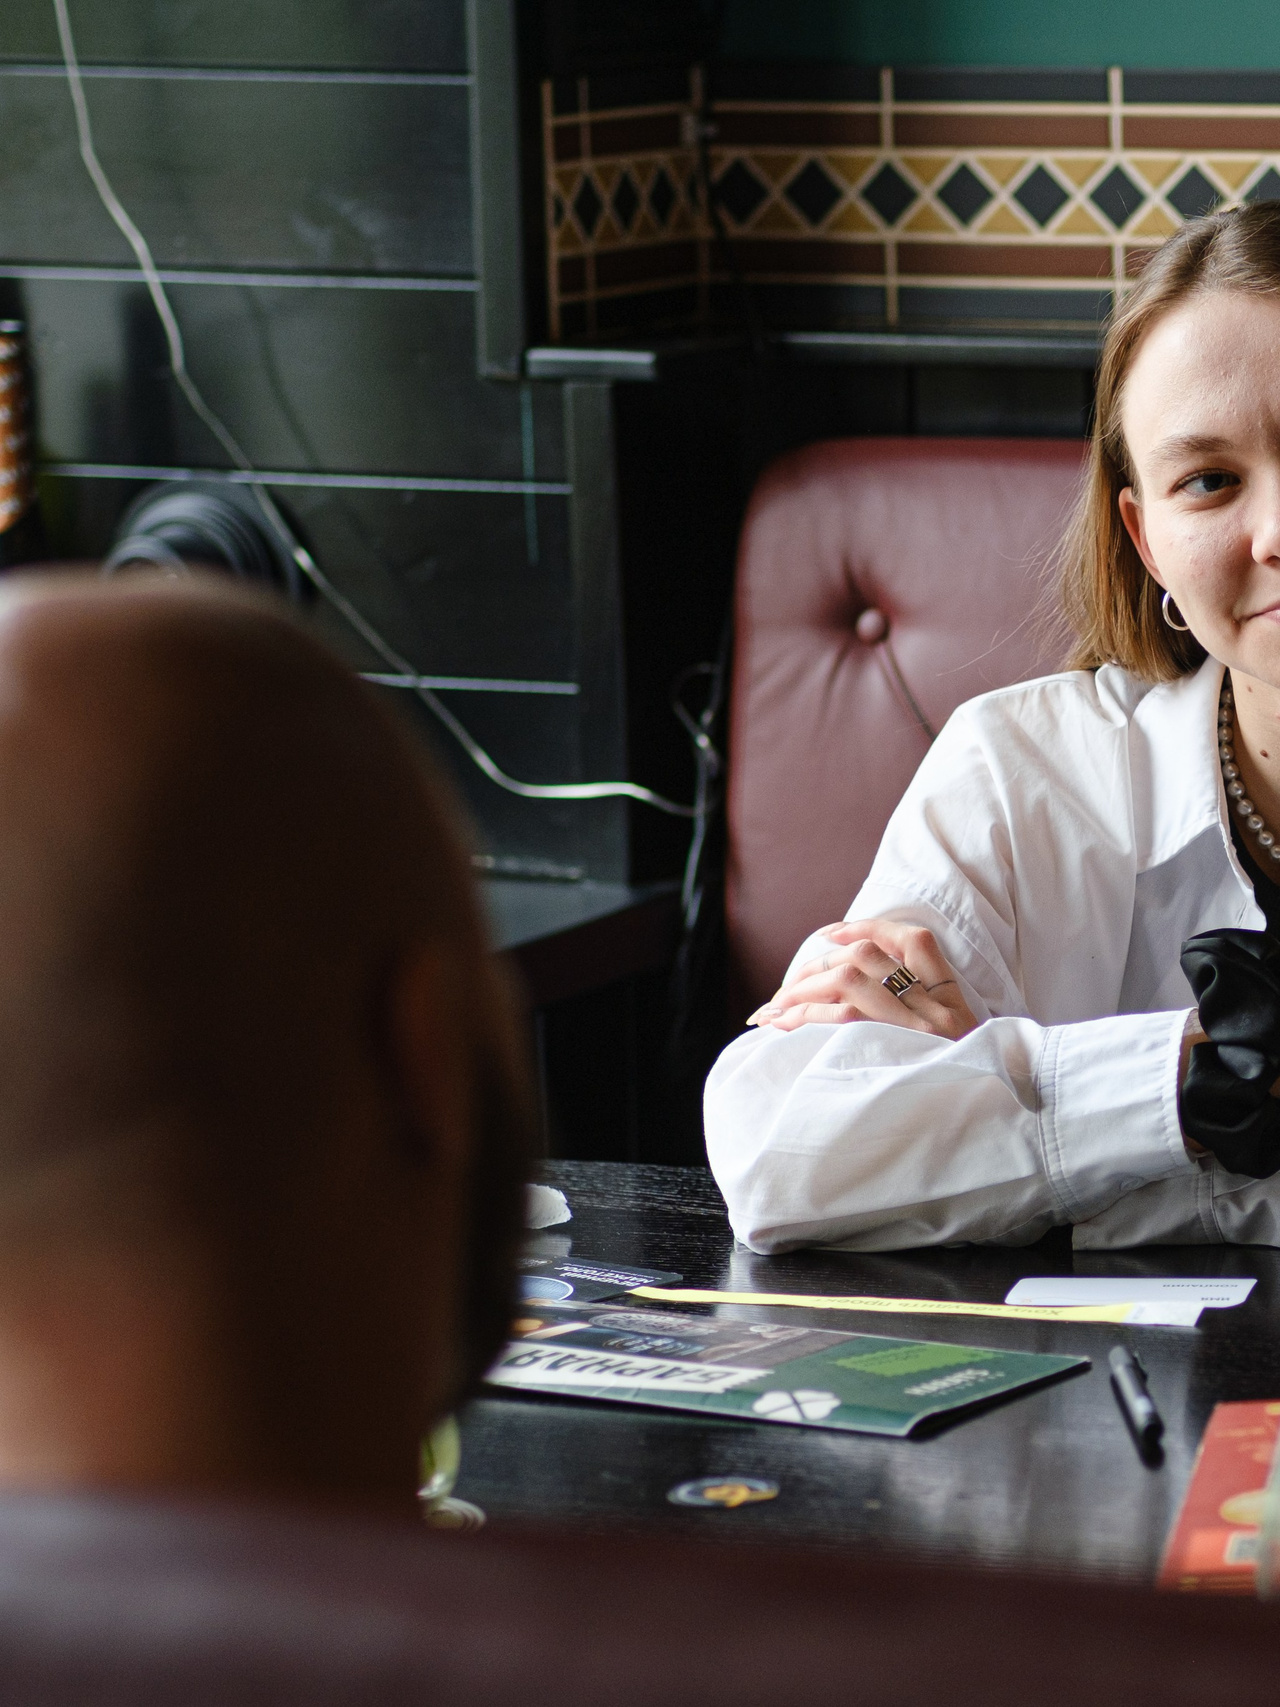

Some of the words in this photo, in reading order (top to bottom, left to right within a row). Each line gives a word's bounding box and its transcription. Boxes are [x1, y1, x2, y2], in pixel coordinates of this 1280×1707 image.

[901, 1301, 1002, 1312] обсудить
[1007, 1307, 1064, 1316] Хочу
[502, 1350, 739, 1384] БАРНАЯ
